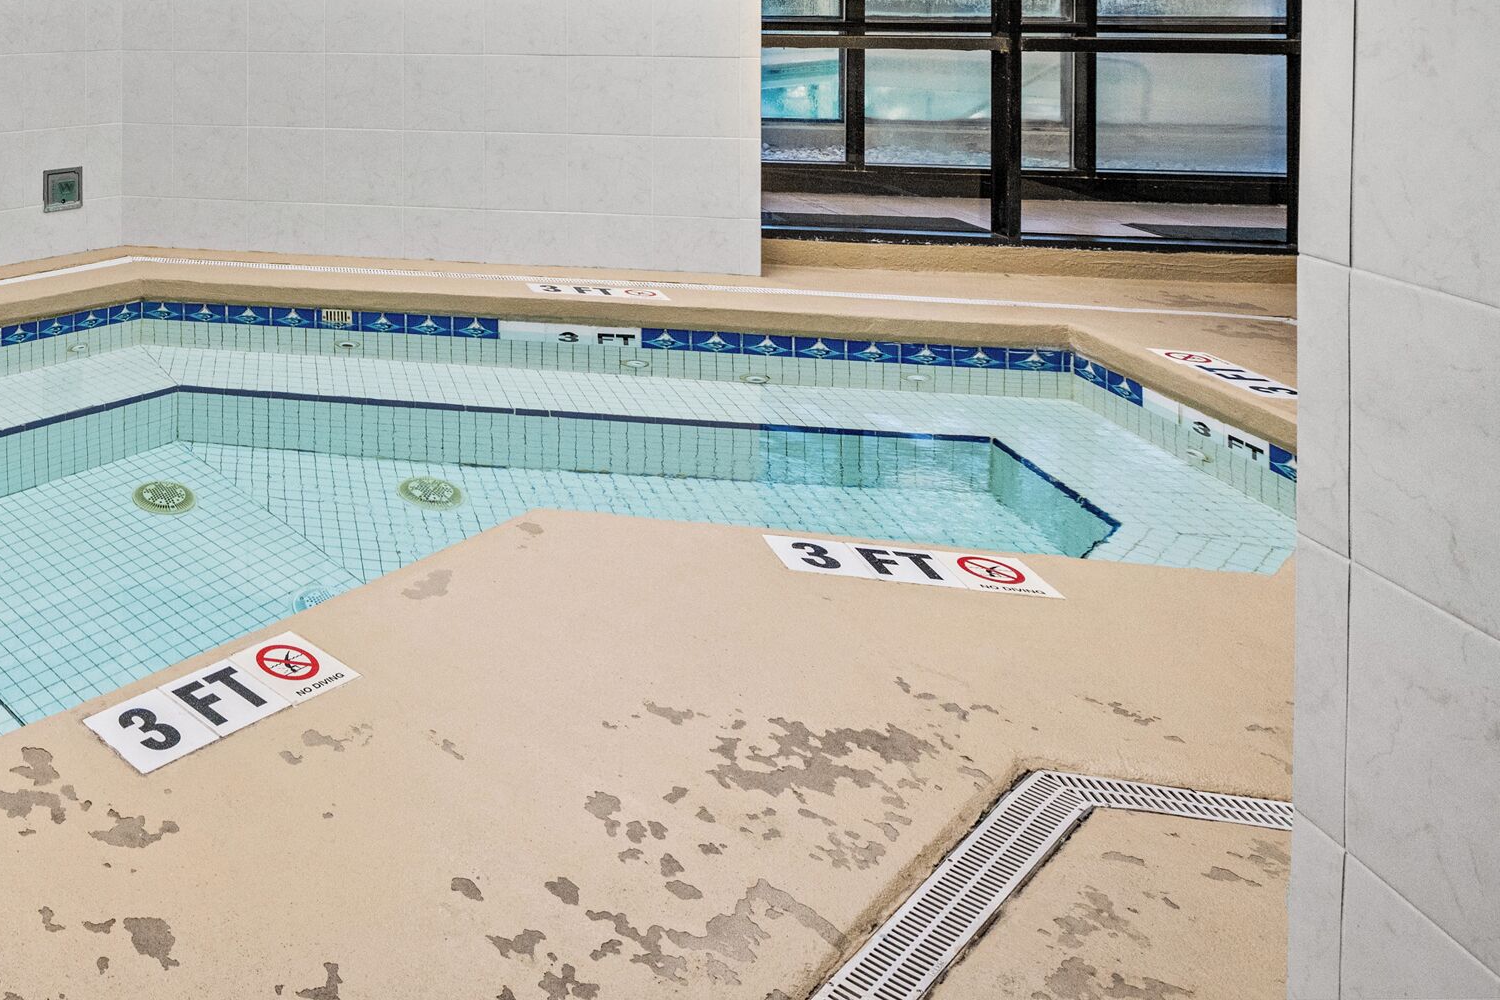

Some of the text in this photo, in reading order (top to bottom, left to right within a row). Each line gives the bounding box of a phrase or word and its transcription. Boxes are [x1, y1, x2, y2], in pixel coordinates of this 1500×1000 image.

[573, 287, 611, 295] FT
[558, 331, 635, 345] 3 FT
[1196, 365, 1270, 382] FT
[1193, 421, 1264, 460] 3 FT
[791, 542, 944, 581] 3 FT
[1002, 586, 1046, 595] DIVING
[295, 672, 345, 697] NO DIVING
[118, 666, 267, 751] 3 FT
